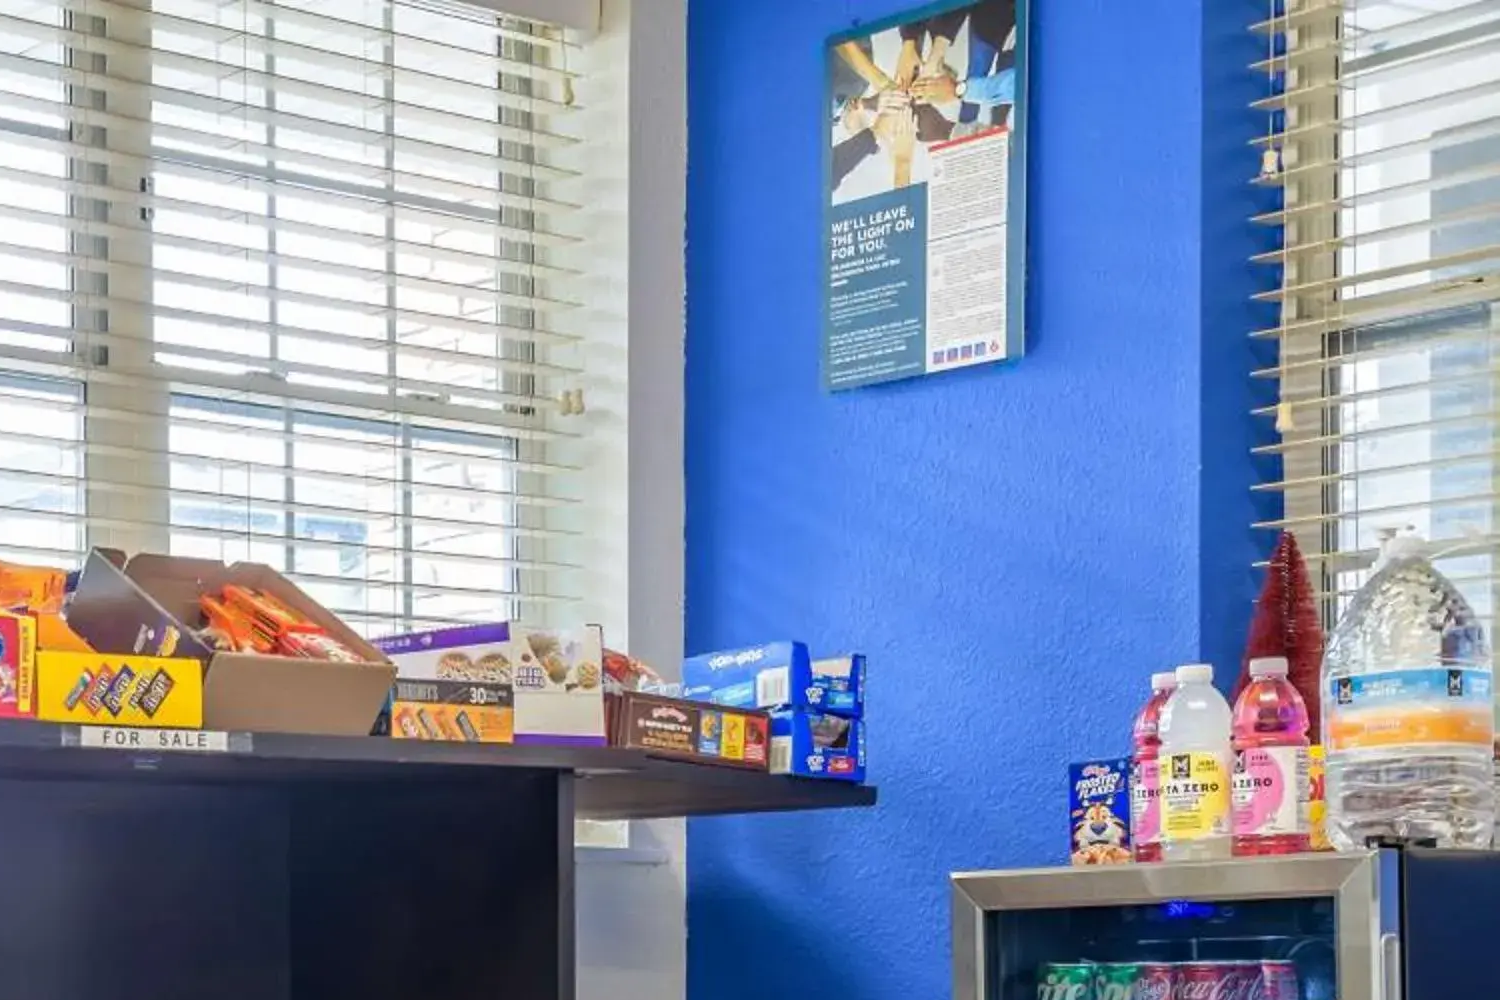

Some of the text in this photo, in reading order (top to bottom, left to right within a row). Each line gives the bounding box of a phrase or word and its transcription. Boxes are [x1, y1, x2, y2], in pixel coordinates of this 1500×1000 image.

[831, 205, 906, 235] WE'LL LEAVE
[831, 216, 915, 248] THE LIGHT ON
[831, 245, 855, 261] FOR
[469, 687, 487, 704] 30
[103, 730, 208, 748] FOR SALE
[1183, 783, 1220, 793] ZERO
[1239, 777, 1273, 789] ZERO
